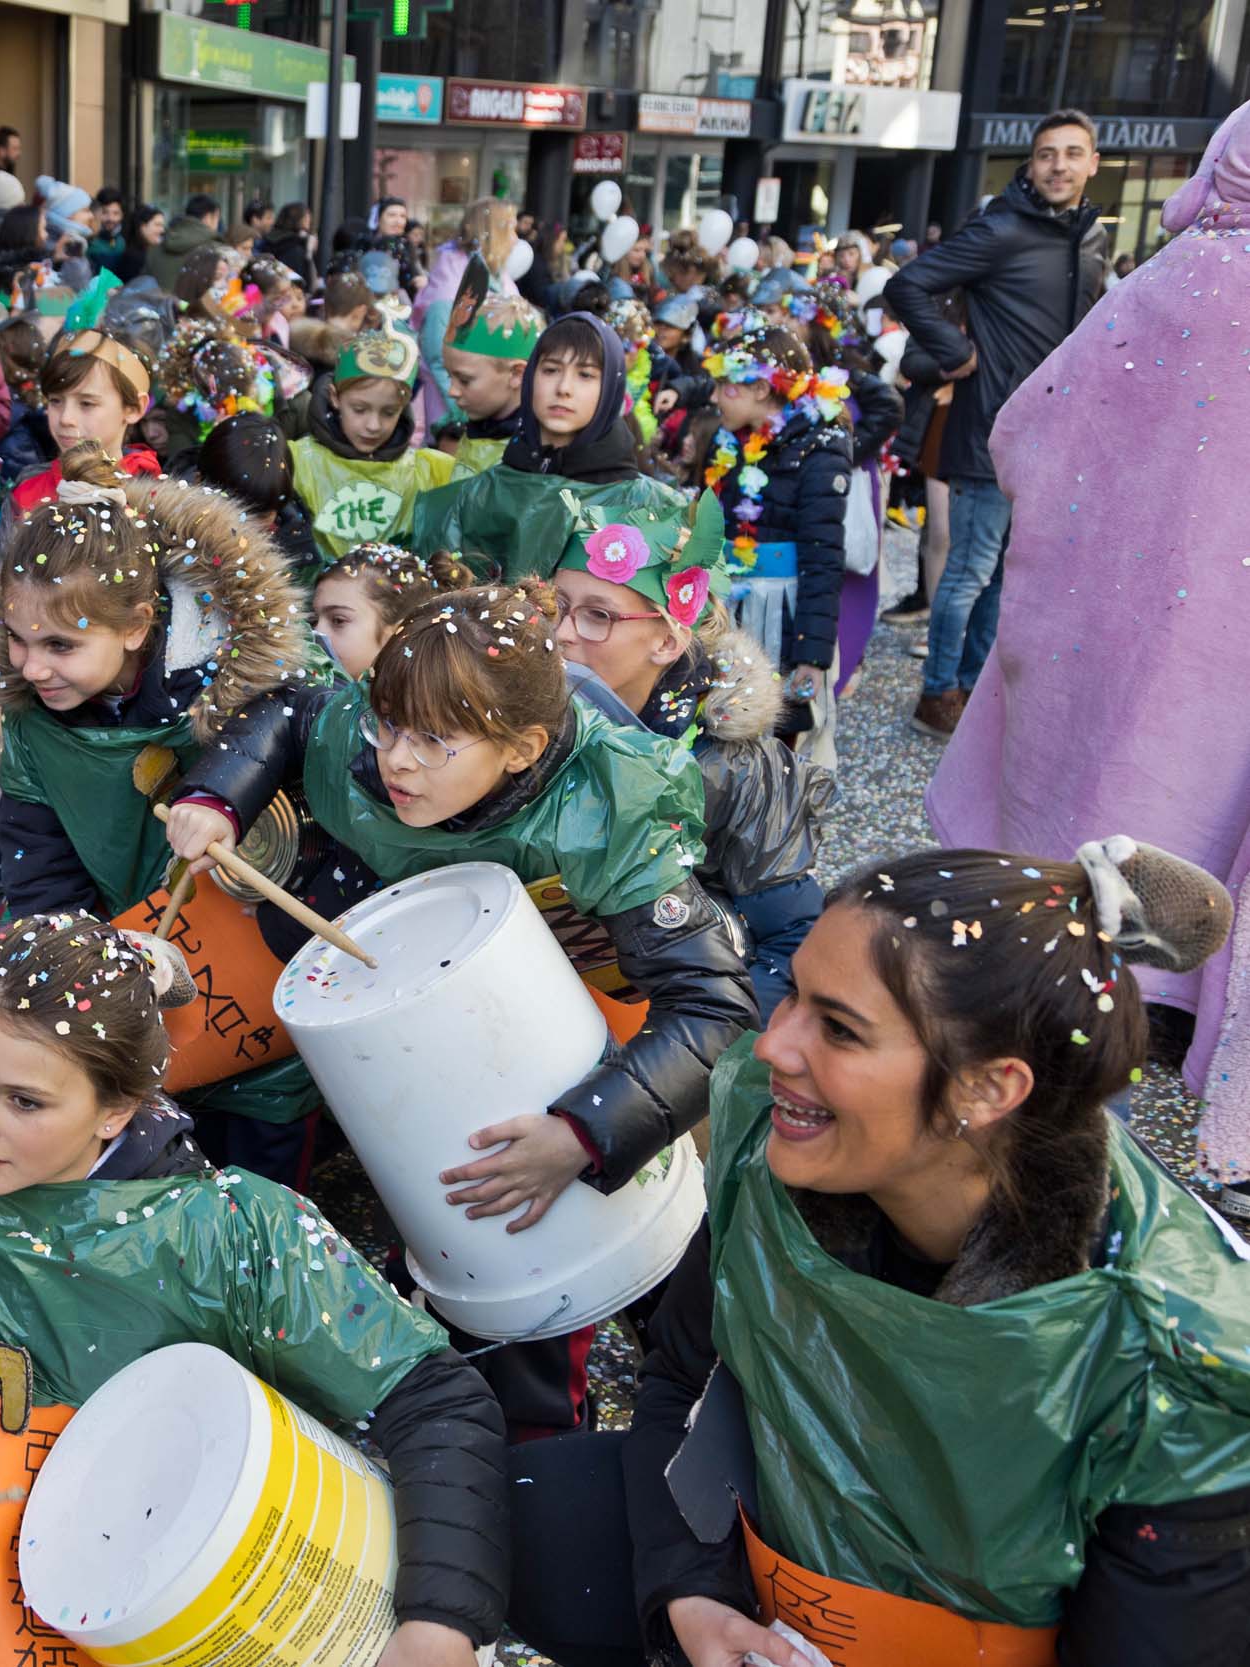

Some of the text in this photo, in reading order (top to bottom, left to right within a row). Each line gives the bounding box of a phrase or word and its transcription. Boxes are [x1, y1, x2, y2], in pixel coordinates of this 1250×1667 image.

[981, 117, 1177, 148] IMMLIÀRIA
[573, 157, 622, 171] ANGELA
[332, 496, 387, 530] THE
